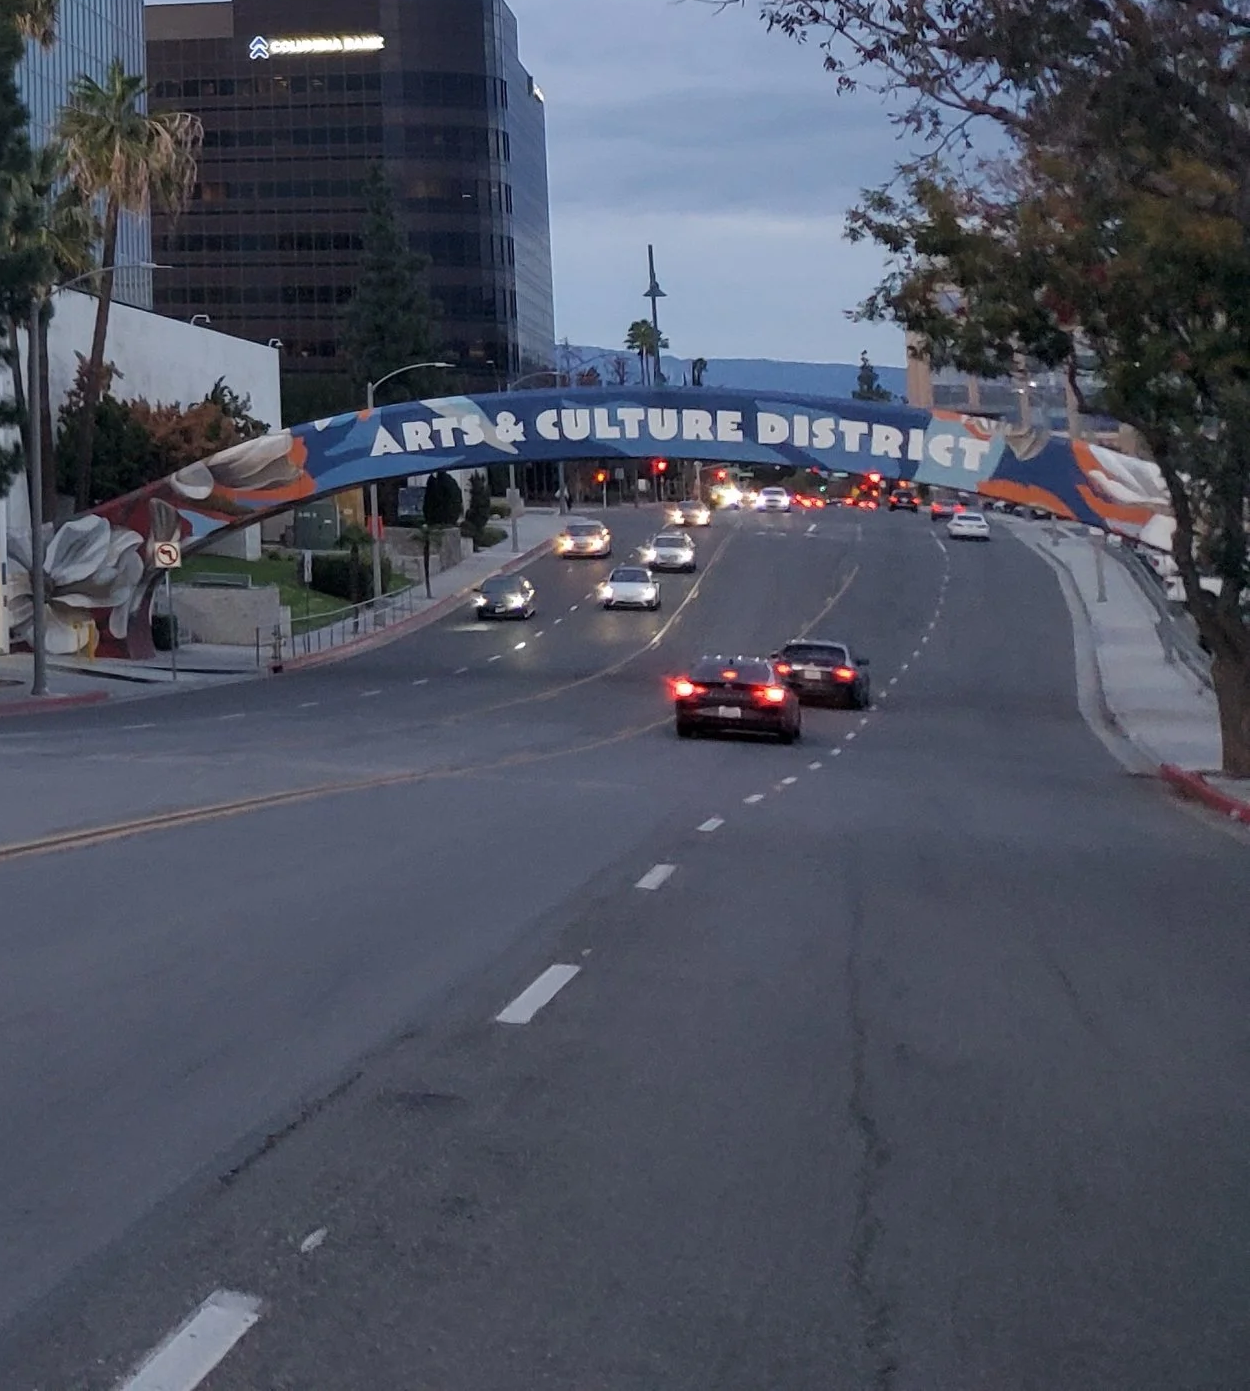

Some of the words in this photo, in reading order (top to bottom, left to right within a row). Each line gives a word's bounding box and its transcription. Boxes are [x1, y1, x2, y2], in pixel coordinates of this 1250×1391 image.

[370, 415, 484, 457] ARTS
[495, 412, 526, 442] &
[535, 408, 743, 441] CULTURE
[757, 413, 988, 471] DISTRICT
